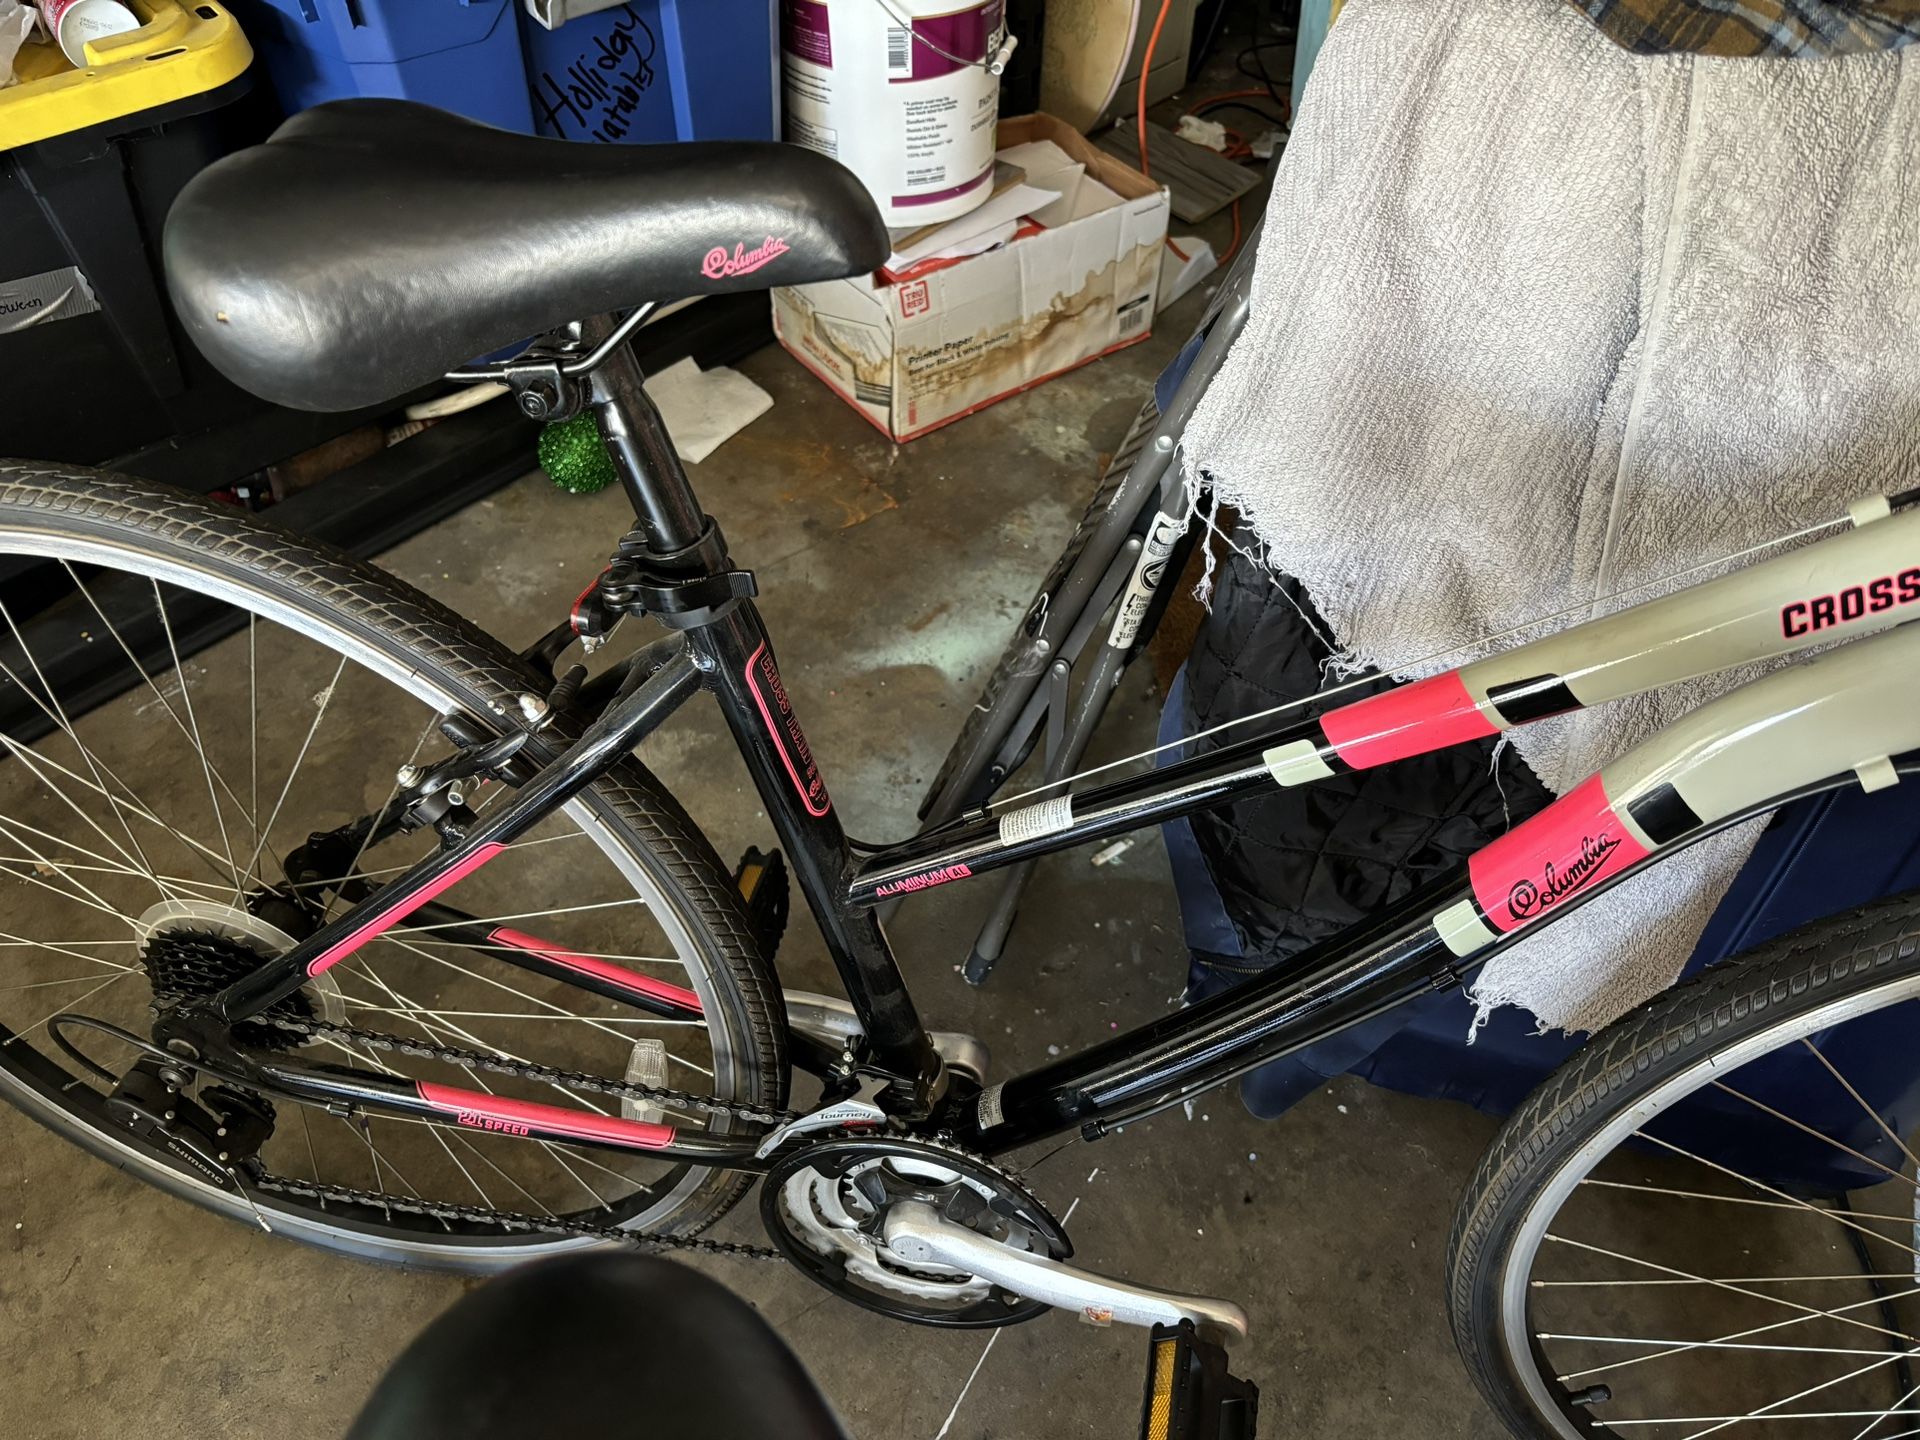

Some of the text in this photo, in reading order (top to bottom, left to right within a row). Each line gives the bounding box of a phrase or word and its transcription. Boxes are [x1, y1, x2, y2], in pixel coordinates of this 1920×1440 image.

[701, 235, 790, 279] Columbia
[908, 335, 974, 366] Printer Paper
[1779, 564, 1920, 641] CROSS
[760, 652, 792, 715] CROSS
[876, 867, 949, 897] ALUMINUM
[1508, 833, 1622, 922] Columbia
[484, 1120, 530, 1136] SPEED
[819, 1112, 872, 1120] Tourney
